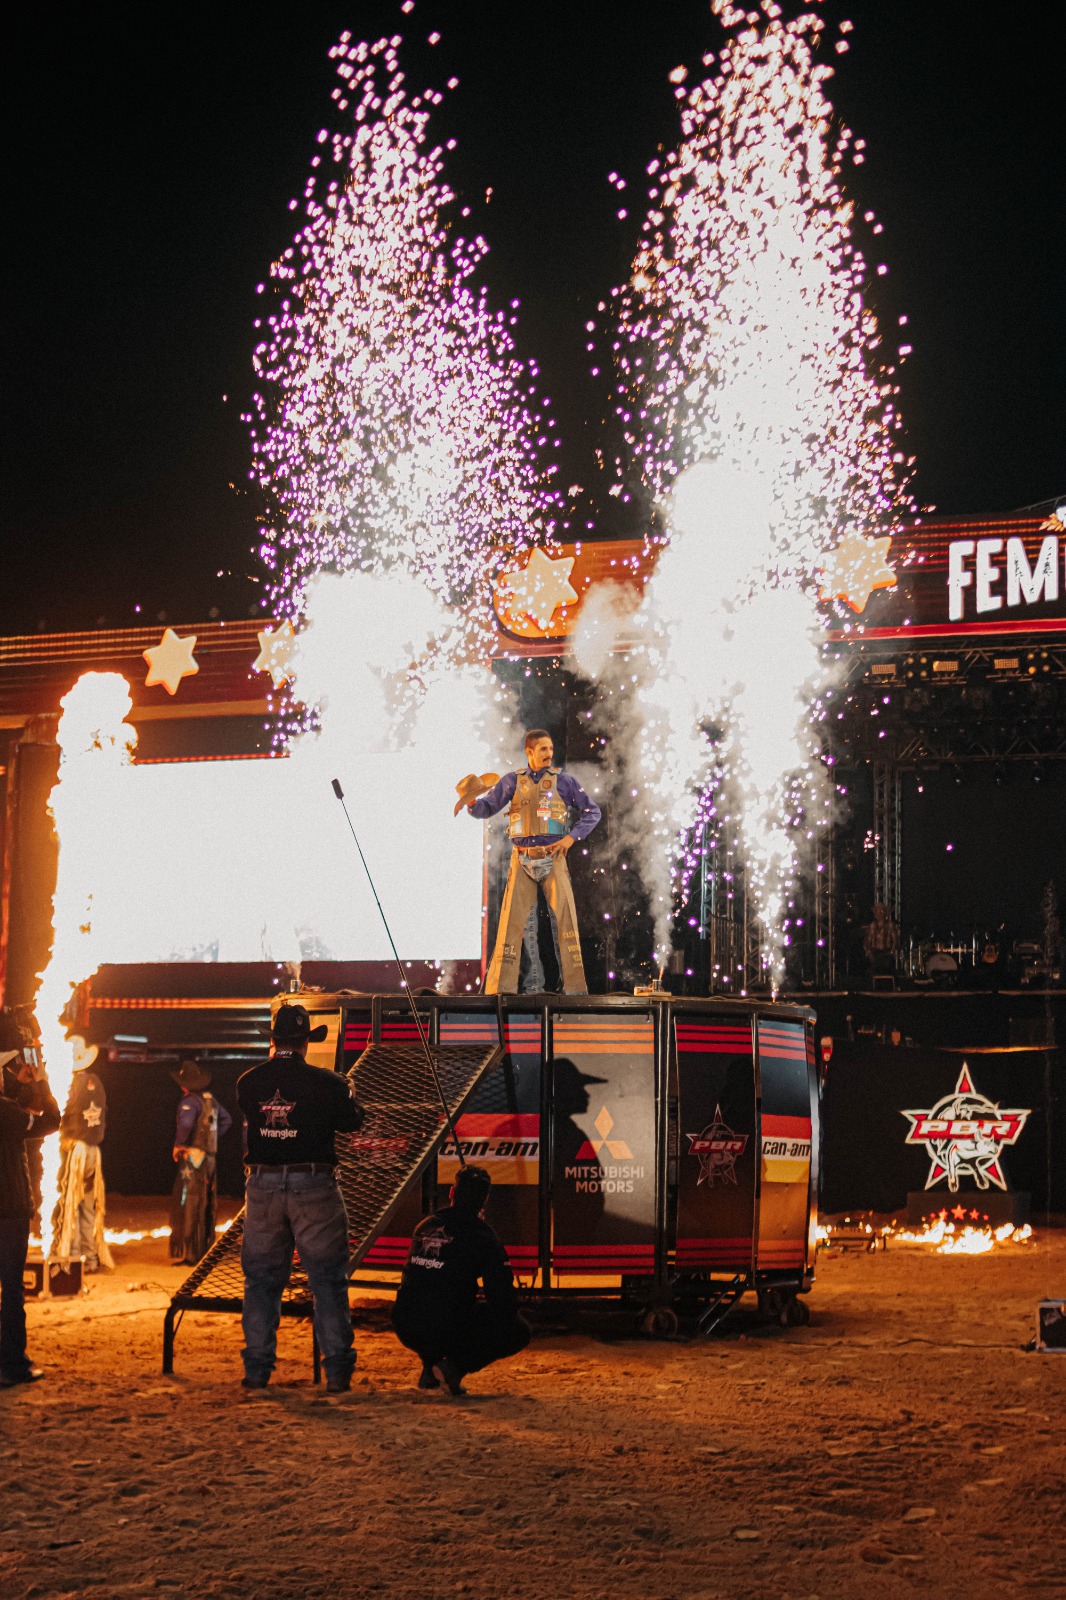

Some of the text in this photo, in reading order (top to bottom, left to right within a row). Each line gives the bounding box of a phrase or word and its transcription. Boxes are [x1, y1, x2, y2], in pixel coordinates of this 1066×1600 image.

[948, 536, 1066, 621] FEM
[260, 1128, 297, 1139] Wrangler
[919, 1120, 1011, 1135] PBR
[439, 1141, 538, 1157] can-am
[694, 1140, 743, 1150] PBR
[763, 1141, 811, 1157] can-am
[565, 1166, 644, 1179] MITSUBISHI
[575, 1180, 634, 1193] MOTORS
[411, 1256, 444, 1269] Wrangler
